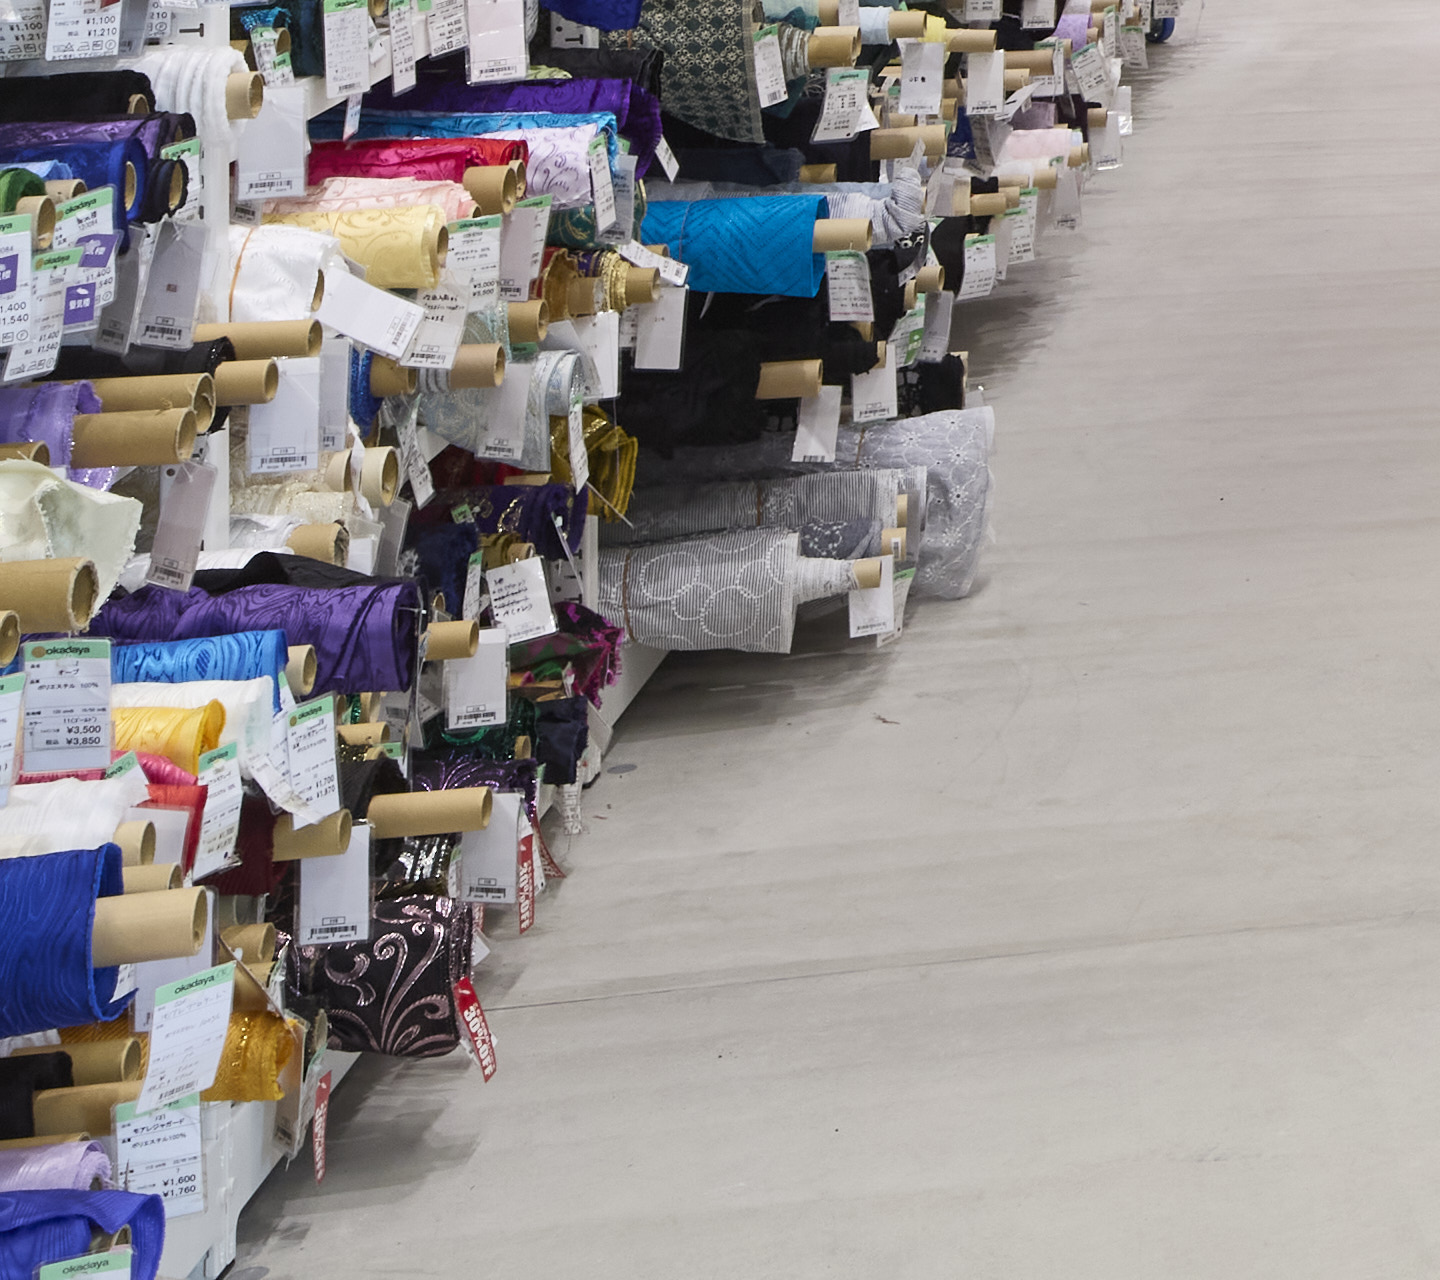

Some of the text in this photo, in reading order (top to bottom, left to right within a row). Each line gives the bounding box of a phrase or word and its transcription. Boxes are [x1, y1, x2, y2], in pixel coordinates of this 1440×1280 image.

[65, 197, 97, 216] okadaya
[46, 646, 90, 655] okadaya
[174, 974, 215, 995] okadaya
[62, 1258, 109, 1275] okadaya
